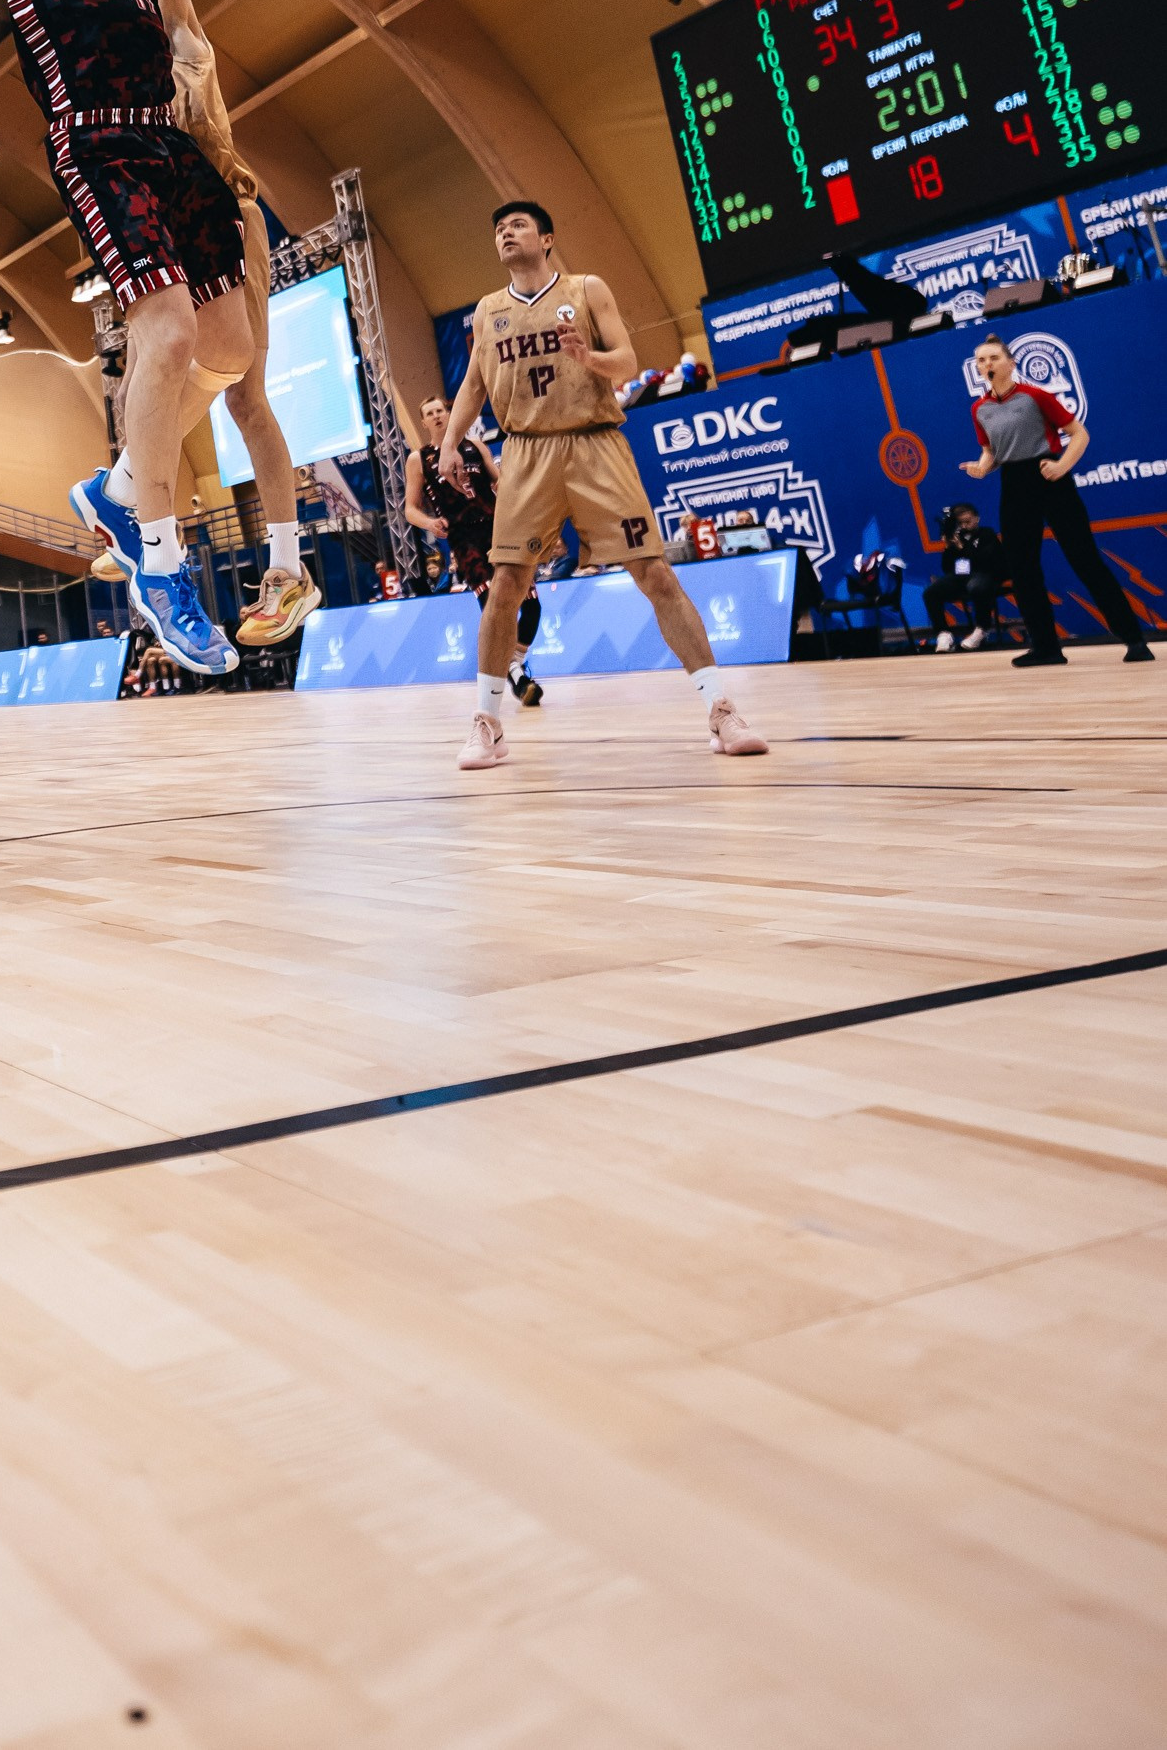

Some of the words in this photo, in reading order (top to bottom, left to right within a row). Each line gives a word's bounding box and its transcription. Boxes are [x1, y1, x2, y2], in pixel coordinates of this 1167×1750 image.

[757, 8, 770, 29] 0
[762, 27, 775, 49] 6
[813, 16, 858, 66] 34
[1029, 17, 1057, 49] 17
[756, 46, 780, 73] 10
[866, 30, 922, 64] ТАЙМАУТЫ
[1034, 41, 1068, 74] 23
[672, 51, 683, 72] 2
[866, 62, 902, 89] ВРЕМЯ
[904, 49, 935, 73] ИГРЫ
[772, 66, 785, 88] 0
[1041, 63, 1071, 98] 27
[777, 85, 790, 107] 9
[875, 62, 968, 132] 2:01
[994, 90, 1028, 113] ФОЛЫ
[1047, 88, 1082, 121] 28
[782, 104, 795, 127] 0
[1055, 112, 1086, 144] 31
[787, 125, 800, 148] 0
[871, 135, 907, 160] ВРЕМЯ
[909, 113, 969, 146] ПЕРЕРЫВА
[1002, 112, 1040, 157] 4
[792, 145, 805, 167] 0
[1062, 134, 1097, 168] 35
[688, 162, 710, 187] 14
[796, 164, 809, 188] 7
[821, 157, 849, 178] ФОЛЫ
[908, 154, 944, 200] 18
[692, 181, 712, 206] 21
[801, 185, 817, 210] 2
[696, 200, 719, 226] 33
[1080, 197, 1132, 224] СРЕДИ
[701, 220, 721, 243] 41
[133, 255, 153, 270] STK
[915, 249, 968, 271] ЧЕМПИОНАТ
[916, 262, 978, 297] ИНАЛ
[710, 302, 768, 329] ЧЕМПИОНАТ
[714, 311, 792, 343] ФЕДЕРАЛЬНОГО
[793, 300, 833, 323] ОКРУГА
[495, 330, 561, 364] ЦИВ
[693, 396, 783, 447] DKC
[662, 448, 730, 473] Титульный
[731, 438, 789, 460] спонсор
[688, 487, 750, 508] ЧЕМПИОНАТ
[751, 481, 777, 499] ЦФО
[765, 506, 814, 537] 4-Х
[697, 524, 716, 551] 5
[385, 575, 398, 596] 5
